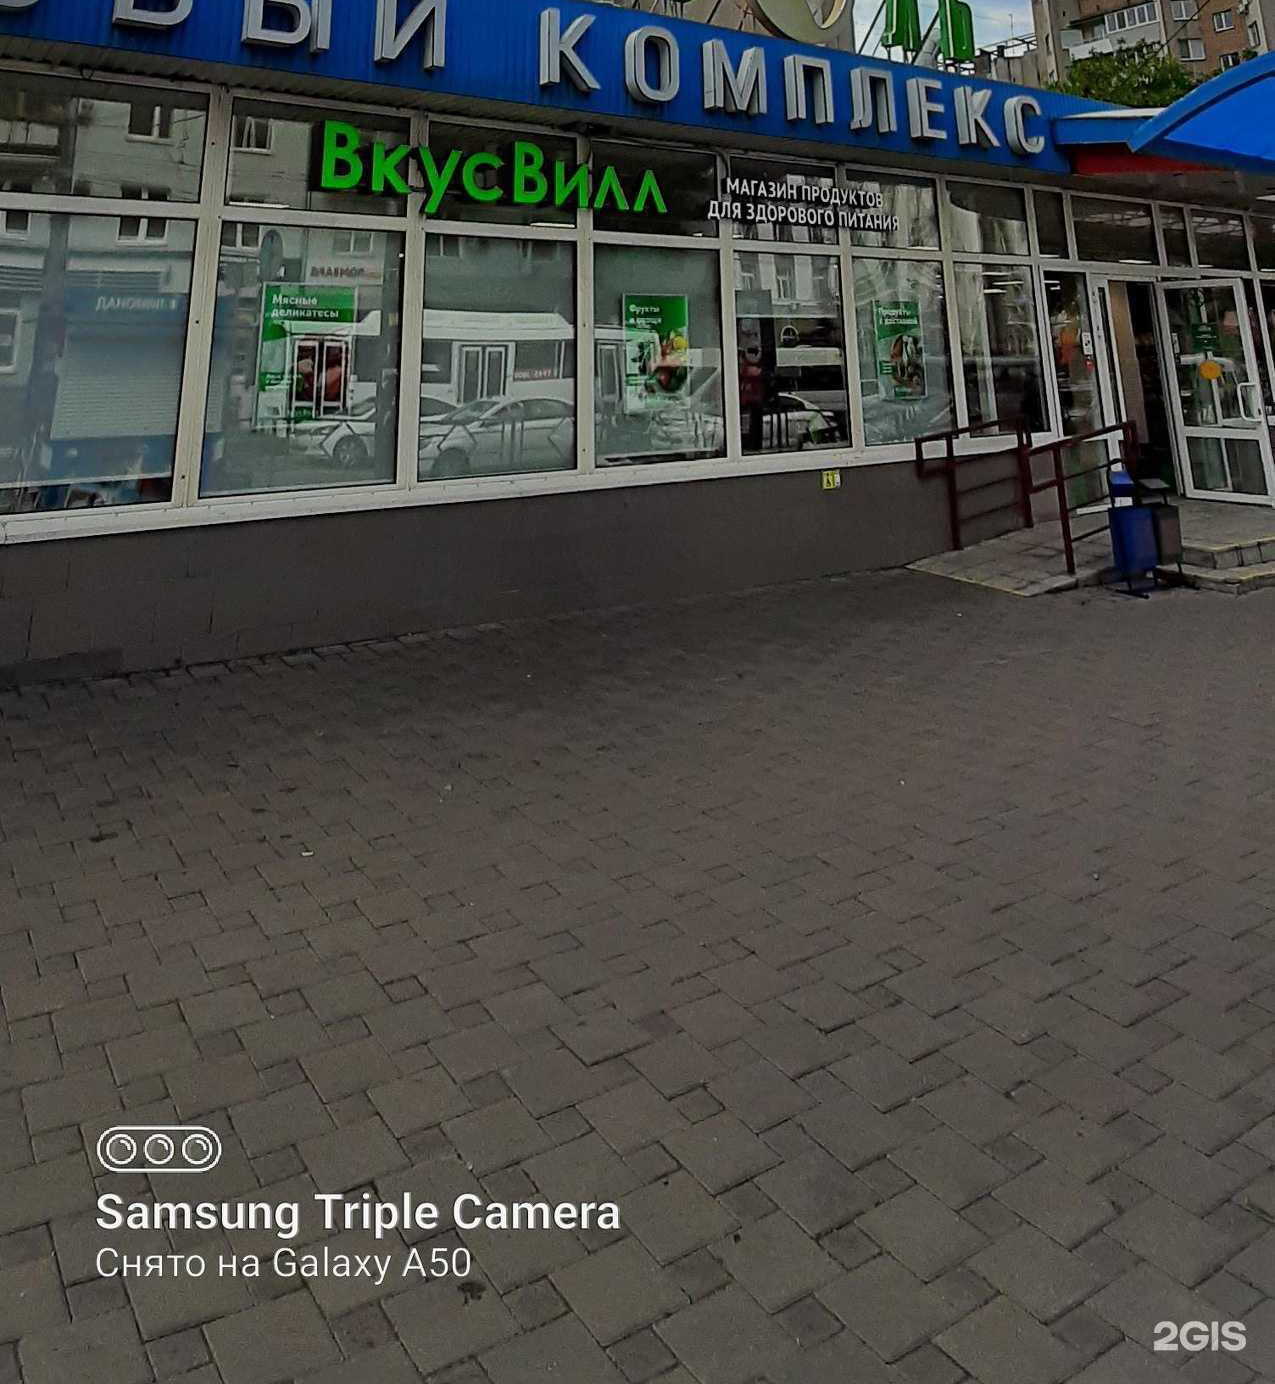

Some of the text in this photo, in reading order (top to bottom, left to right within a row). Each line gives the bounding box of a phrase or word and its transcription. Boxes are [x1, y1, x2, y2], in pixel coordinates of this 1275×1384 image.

[539, 7, 1047, 155] КОМПЛЕКС
[726, 176, 883, 208] МАГАЗИН ПРОДУКТОВ
[707, 200, 900, 232] ДЛЯ ЗДОРОВОГО ПИТАНИЯ
[270, 307, 339, 318] деликатесы
[271, 294, 318, 305] Мясные
